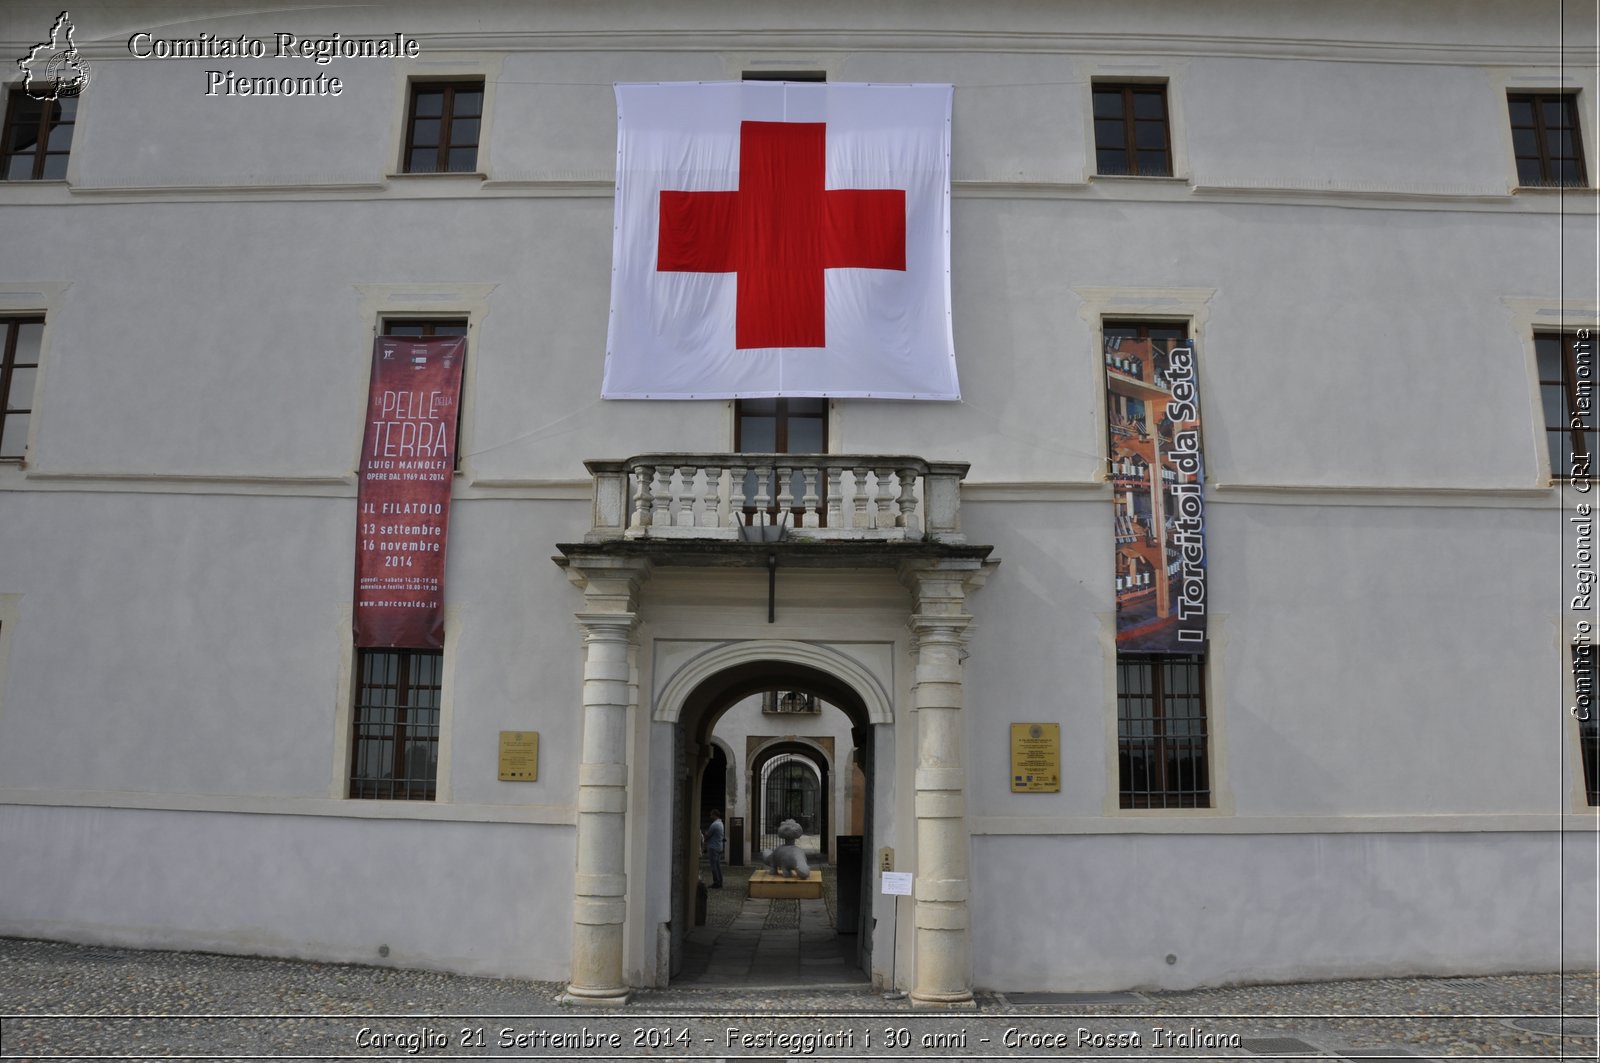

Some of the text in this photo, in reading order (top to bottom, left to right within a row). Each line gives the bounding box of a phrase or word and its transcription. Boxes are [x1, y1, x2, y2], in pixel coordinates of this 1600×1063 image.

[382, 391, 441, 419] PELLE
[435, 396, 452, 406] DELLA
[373, 421, 447, 457] TERRA
[368, 461, 446, 470] LUIGI MAINOLFI
[1166, 348, 1204, 642] I Torcitoi da Seta
[364, 503, 442, 514] IL FILATOIO
[363, 524, 441, 536] 13 settembre
[362, 540, 440, 551] 16 novembre
[385, 556, 412, 567] 2014
